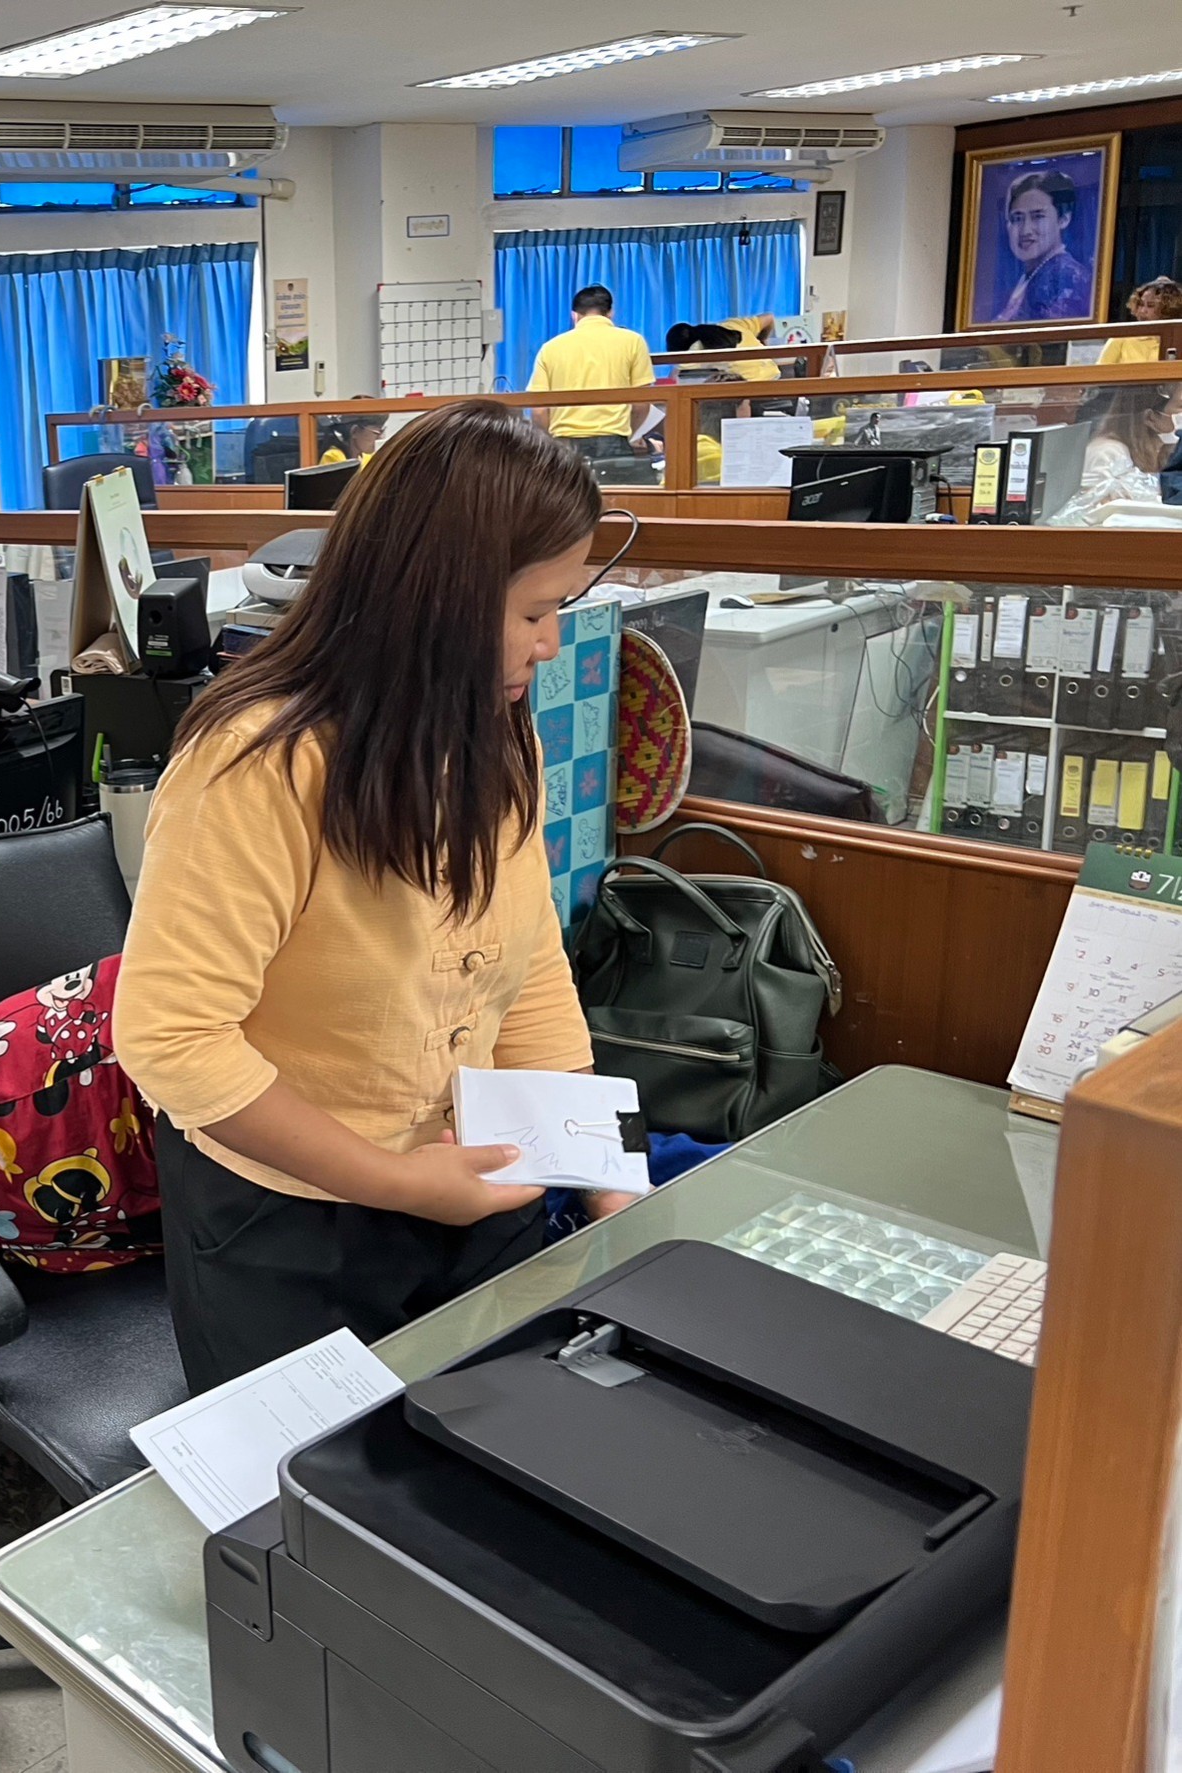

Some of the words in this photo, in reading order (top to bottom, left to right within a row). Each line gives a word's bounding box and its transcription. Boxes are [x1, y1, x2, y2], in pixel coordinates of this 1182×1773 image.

[801, 492, 823, 506] acer
[1078, 950, 1086, 959] 2
[1104, 956, 1112, 964] 3
[1157, 968, 1165, 976] 5
[1089, 988, 1100, 997] 10
[1043, 1033, 1056, 1043] 23
[1068, 1040, 1082, 1050] 24
[1037, 1045, 1052, 1055] 30
[1066, 1053, 1077, 1062] 31
